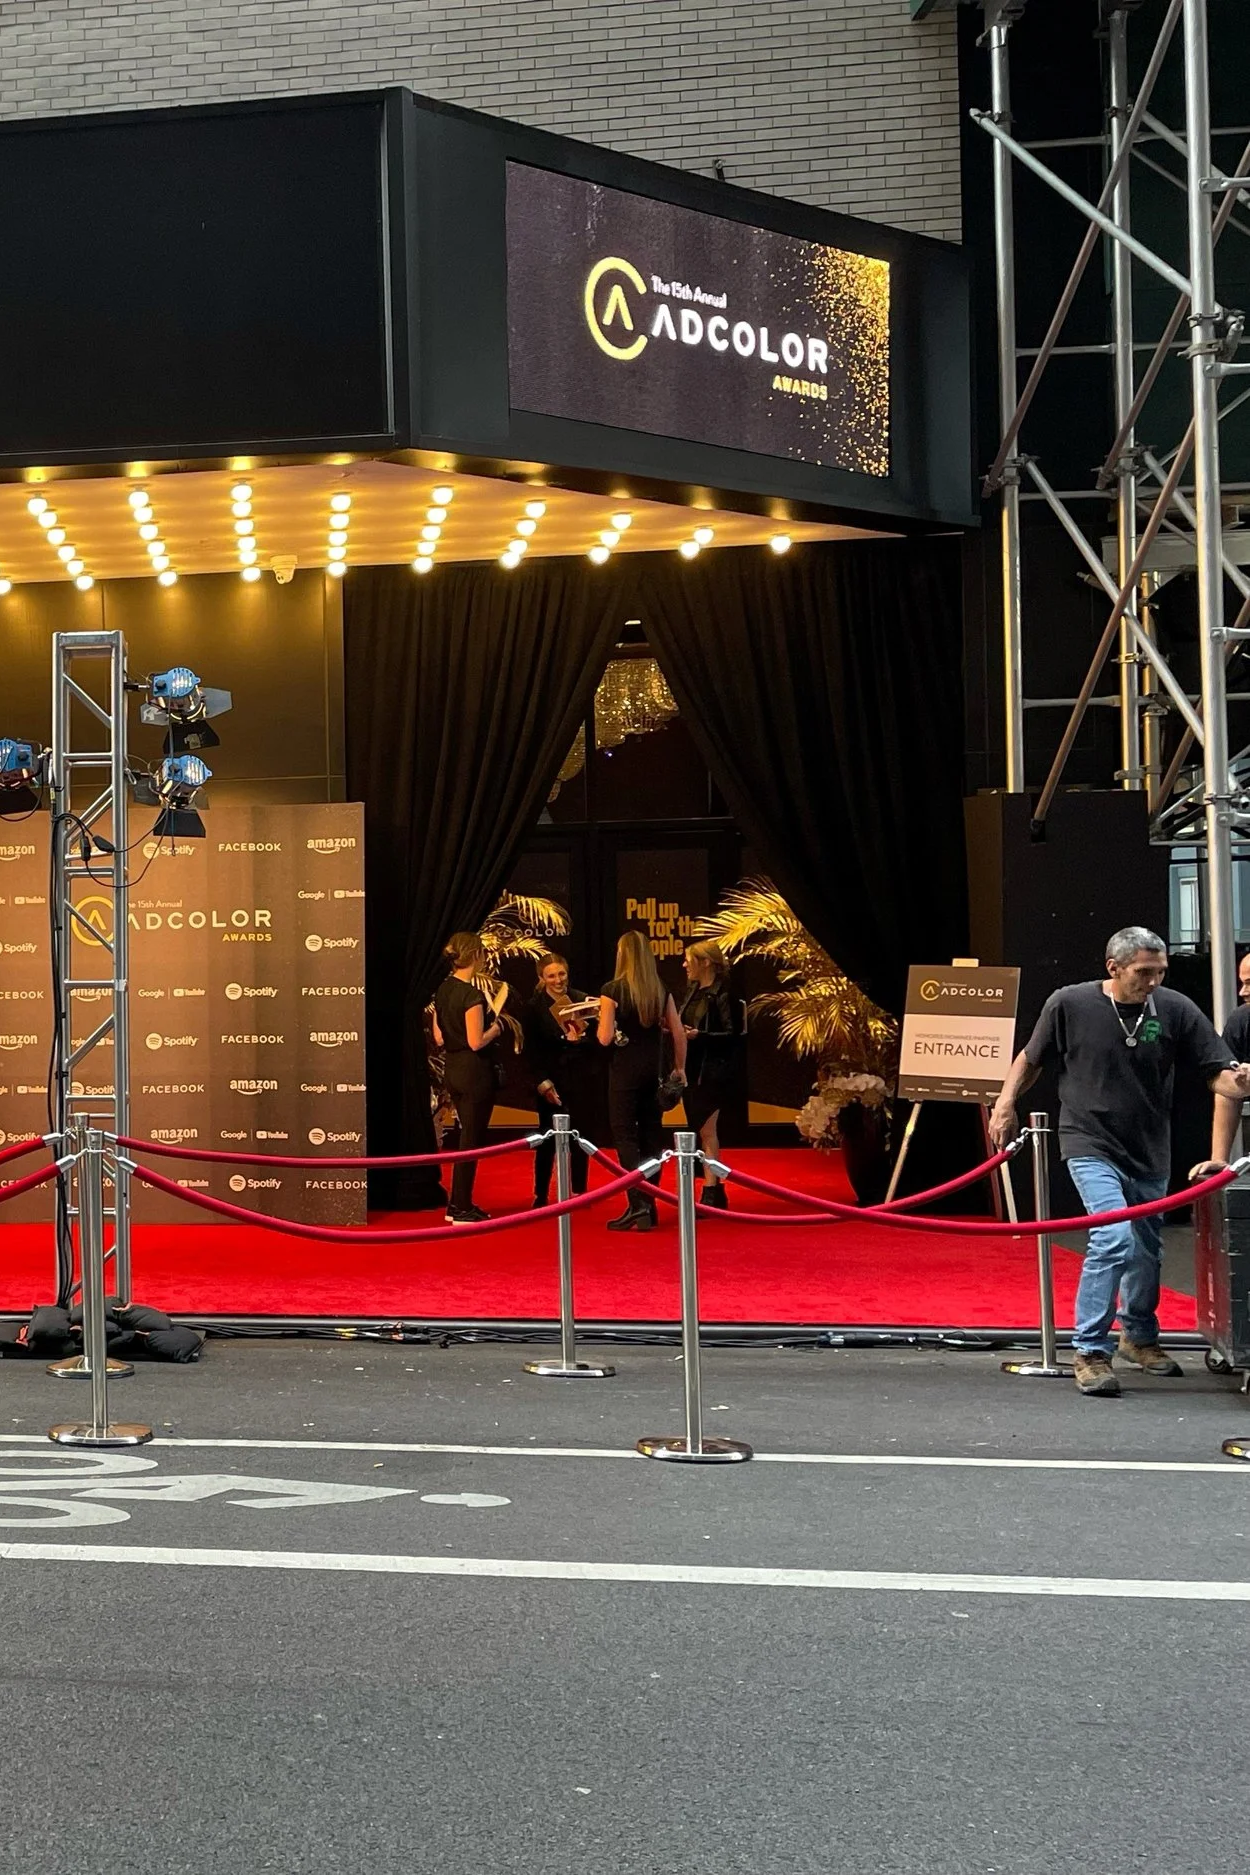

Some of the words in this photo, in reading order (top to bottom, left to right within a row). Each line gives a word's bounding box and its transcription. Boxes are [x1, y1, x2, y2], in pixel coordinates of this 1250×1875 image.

[651, 275, 671, 295] The
[672, 281, 693, 301] 15th
[694, 287, 727, 309] Annual
[651, 304, 828, 374] ADCOLOR
[772, 375, 828, 401] AWARDS
[218, 844, 281, 852] FACEBOOK
[307, 838, 355, 849] amazon
[298, 891, 325, 900] Google
[138, 900, 154, 908] 15th
[155, 900, 182, 908] Annual
[626, 898, 656, 919] Pull
[659, 903, 679, 923] up
[128, 910, 272, 930] ADCOLOR
[648, 919, 674, 937] for
[4, 943, 37, 954] Spotify
[324, 938, 358, 949] Spotify
[650, 935, 683, 960] ople
[138, 988, 164, 998] Google
[243, 986, 277, 997] Spotify
[302, 987, 365, 995] FACEBOOK
[941, 987, 1003, 997] ADCOLOR
[164, 1036, 198, 1046] Spotify
[221, 1035, 284, 1043] FACEBOOK
[310, 1031, 357, 1043] amazon
[914, 1042, 1000, 1058] ENTRANCE
[85, 1085, 115, 1095] Spotif
[143, 1085, 204, 1093] FACEBOOK
[230, 1080, 277, 1091] amazon
[301, 1084, 327, 1093] Google
[151, 1129, 198, 1140] amazon
[221, 1131, 246, 1139] Google
[327, 1131, 361, 1142] Spotify
[248, 1178, 281, 1189] Spotify
